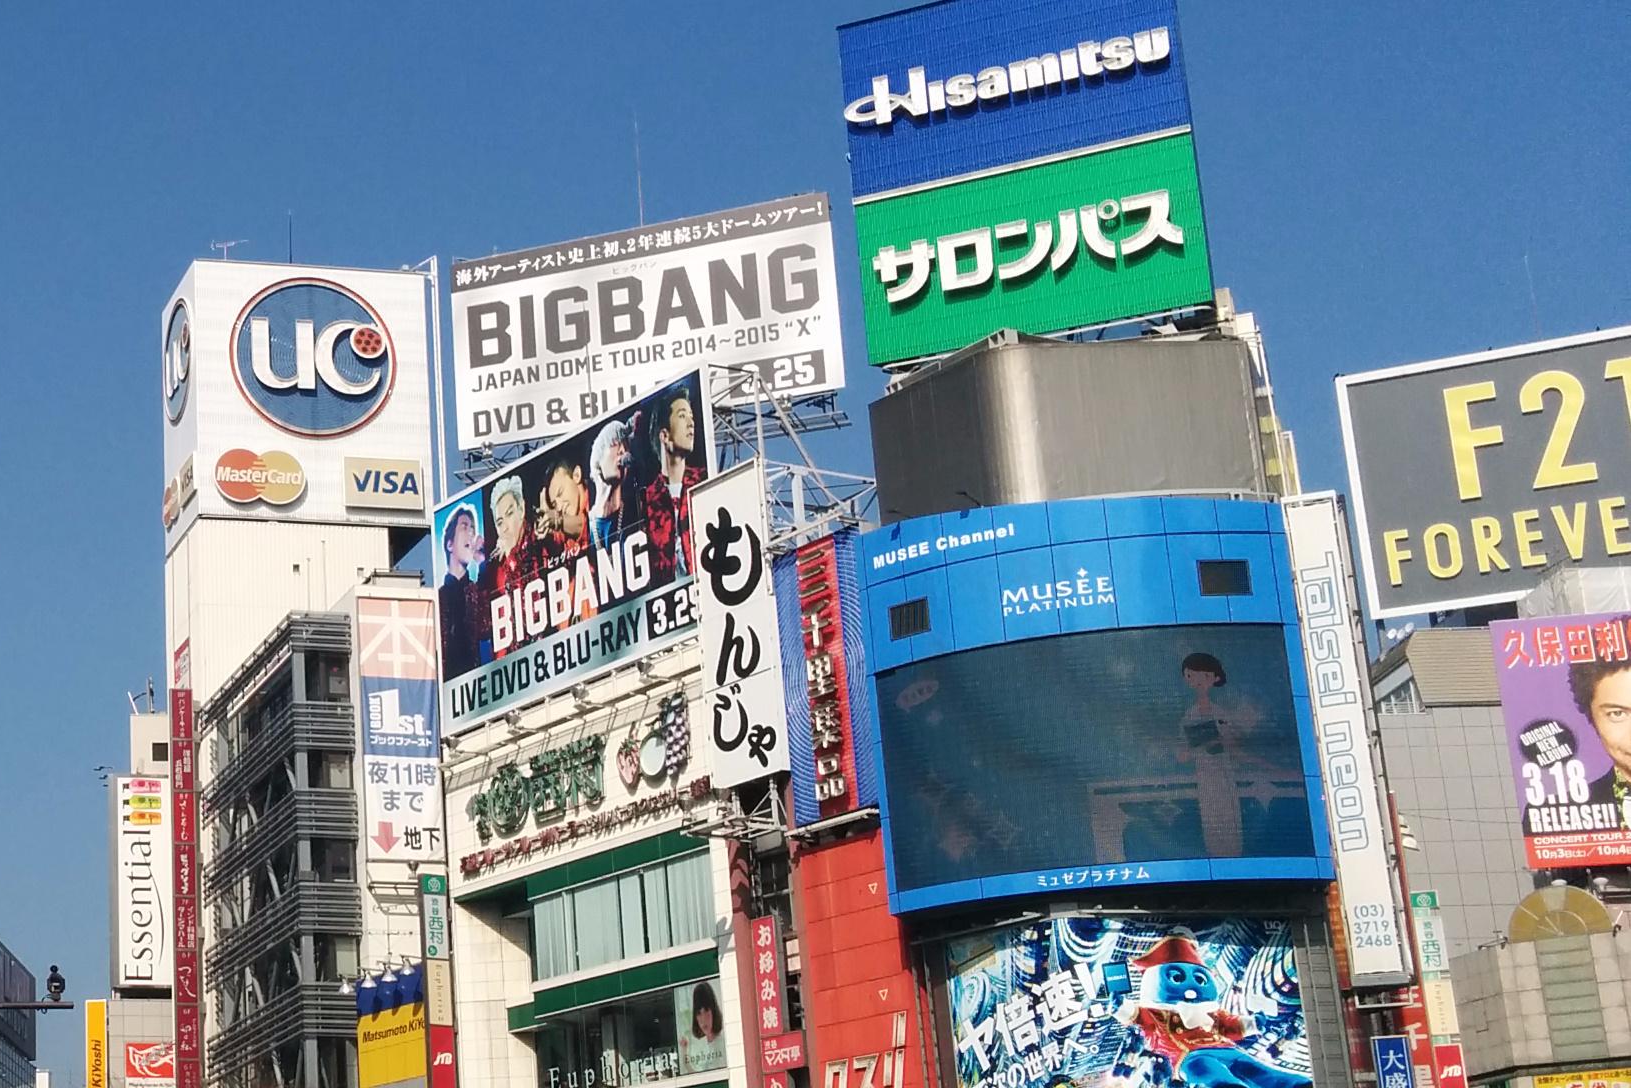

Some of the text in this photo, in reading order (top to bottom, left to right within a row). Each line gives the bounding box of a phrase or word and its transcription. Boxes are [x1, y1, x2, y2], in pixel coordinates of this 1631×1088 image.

[844, 26, 1170, 125] Hisamitsu
[872, 189, 1184, 303] サロンパス
[467, 243, 821, 369] BIGBANG
[471, 364, 540, 393] JAPAN
[546, 354, 603, 379] DOME
[608, 343, 665, 366] TOUR
[472, 406, 536, 438] DVD
[546, 397, 570, 424] &
[216, 465, 304, 486] MasterCard
[353, 470, 420, 495] VISA
[872, 522, 1016, 570] MUSEE Channel
[490, 530, 652, 653] BIGBANG
[1003, 593, 1115, 617] PLATINUM
[357, 599, 436, 678] 本
[699, 505, 777, 768] もんじゃ
[1501, 618, 1631, 669] 久保田利
[451, 676, 488, 720] LIVE
[491, 658, 530, 703] DVD
[533, 654, 551, 682] &
[553, 609, 643, 674] BLU-RAY
[369, 734, 433, 747] ブックファースト
[1519, 720, 1565, 748] ORIGINAL
[1536, 734, 1560, 753] NEW
[1536, 742, 1573, 767] ALBUM!
[368, 761, 437, 786] 夜11時
[1323, 719, 1370, 854] neon
[1521, 759, 1590, 807] 3.18
[382, 789, 424, 813] まで
[1528, 803, 1618, 833] RELEASE!!
[403, 826, 441, 852] 地下
[1533, 831, 1624, 845] CONCERT TOUR
[1037, 865, 1151, 887] ミュゼプラチナム
[124, 829, 154, 983] Essential
[1353, 903, 1386, 918] (03)
[1353, 920, 1390, 936] 3719
[1355, 934, 1393, 949] 2468
[1421, 940, 1442, 968] 西村
[757, 924, 779, 1030] お好み焼
[958, 962, 1105, 1073] ヤ倍速!
[362, 1022, 409, 1044] Matsumoto
[91, 1039, 103, 1088] KiYoshi
[432, 1052, 453, 1066] JTB
[1440, 1064, 1462, 1079] JTB
